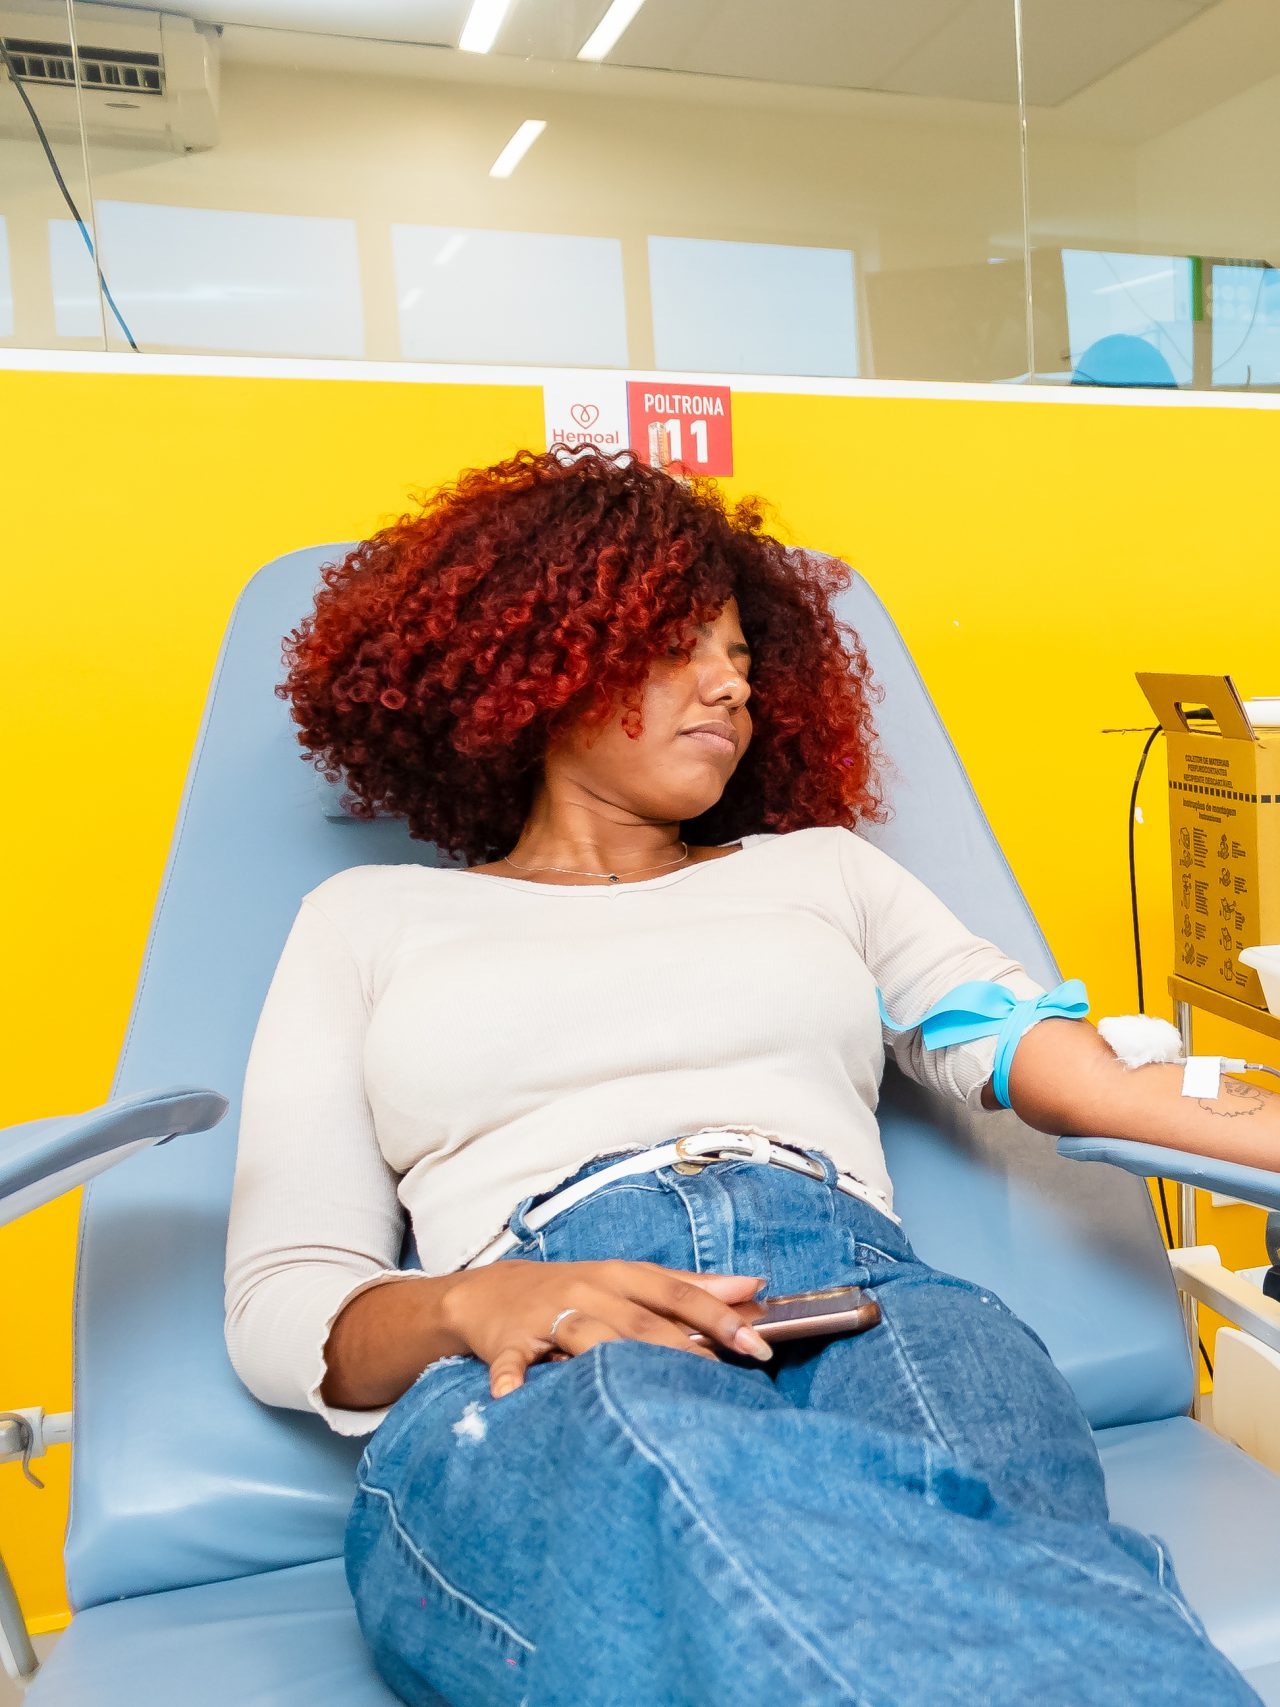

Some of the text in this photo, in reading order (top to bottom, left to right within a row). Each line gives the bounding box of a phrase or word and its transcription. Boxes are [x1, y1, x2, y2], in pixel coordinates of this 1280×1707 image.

[643, 393, 726, 417] POLTRONA
[552, 428, 619, 444] Hemoal
[664, 418, 709, 464] 11
